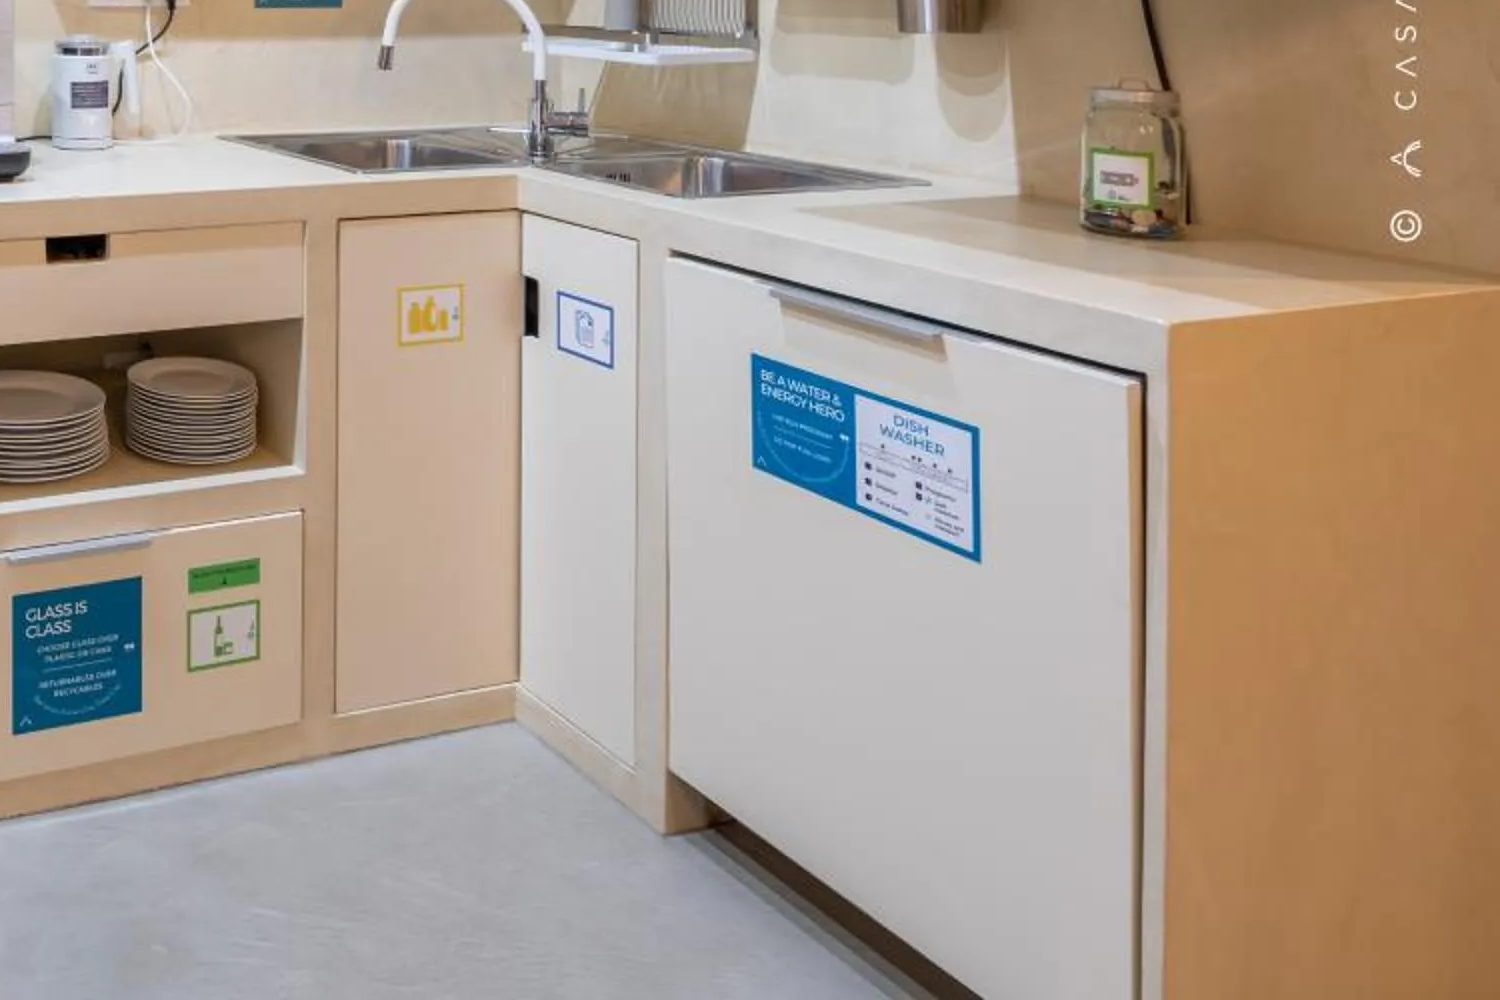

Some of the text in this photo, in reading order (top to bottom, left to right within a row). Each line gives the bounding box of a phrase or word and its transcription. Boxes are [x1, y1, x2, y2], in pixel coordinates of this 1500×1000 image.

[759, 369, 842, 406] BE A WATER &
[760, 383, 845, 423] ENERGY HERO
[893, 415, 930, 436] DISH
[878, 423, 946, 457] WASHER
[25, 600, 88, 622] GLASS IS
[25, 620, 72, 639] CLASS
